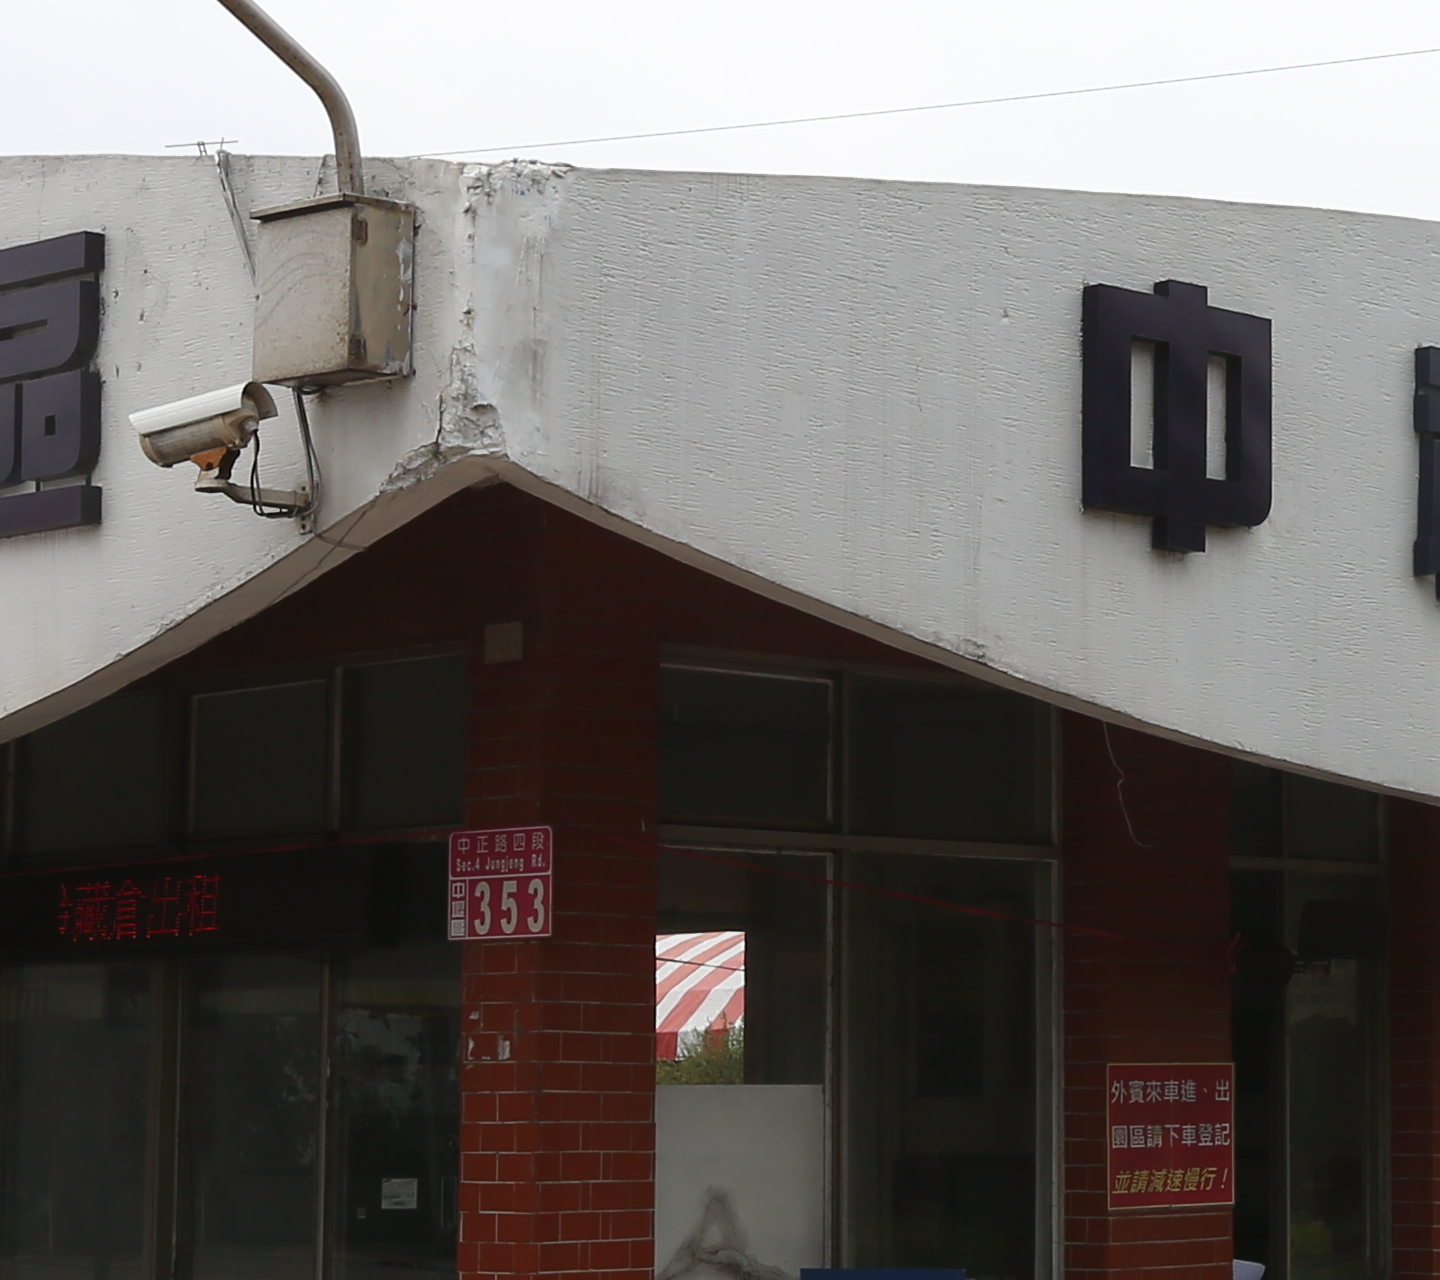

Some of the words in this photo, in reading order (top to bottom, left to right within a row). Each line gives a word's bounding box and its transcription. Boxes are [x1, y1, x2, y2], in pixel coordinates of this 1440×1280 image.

[457, 831, 544, 854] 中正路四段
[473, 878, 544, 935] 353
[1110, 1078, 1230, 1104] 外賓來車進、出
[1110, 1123, 1231, 1149] 園區請下車登記
